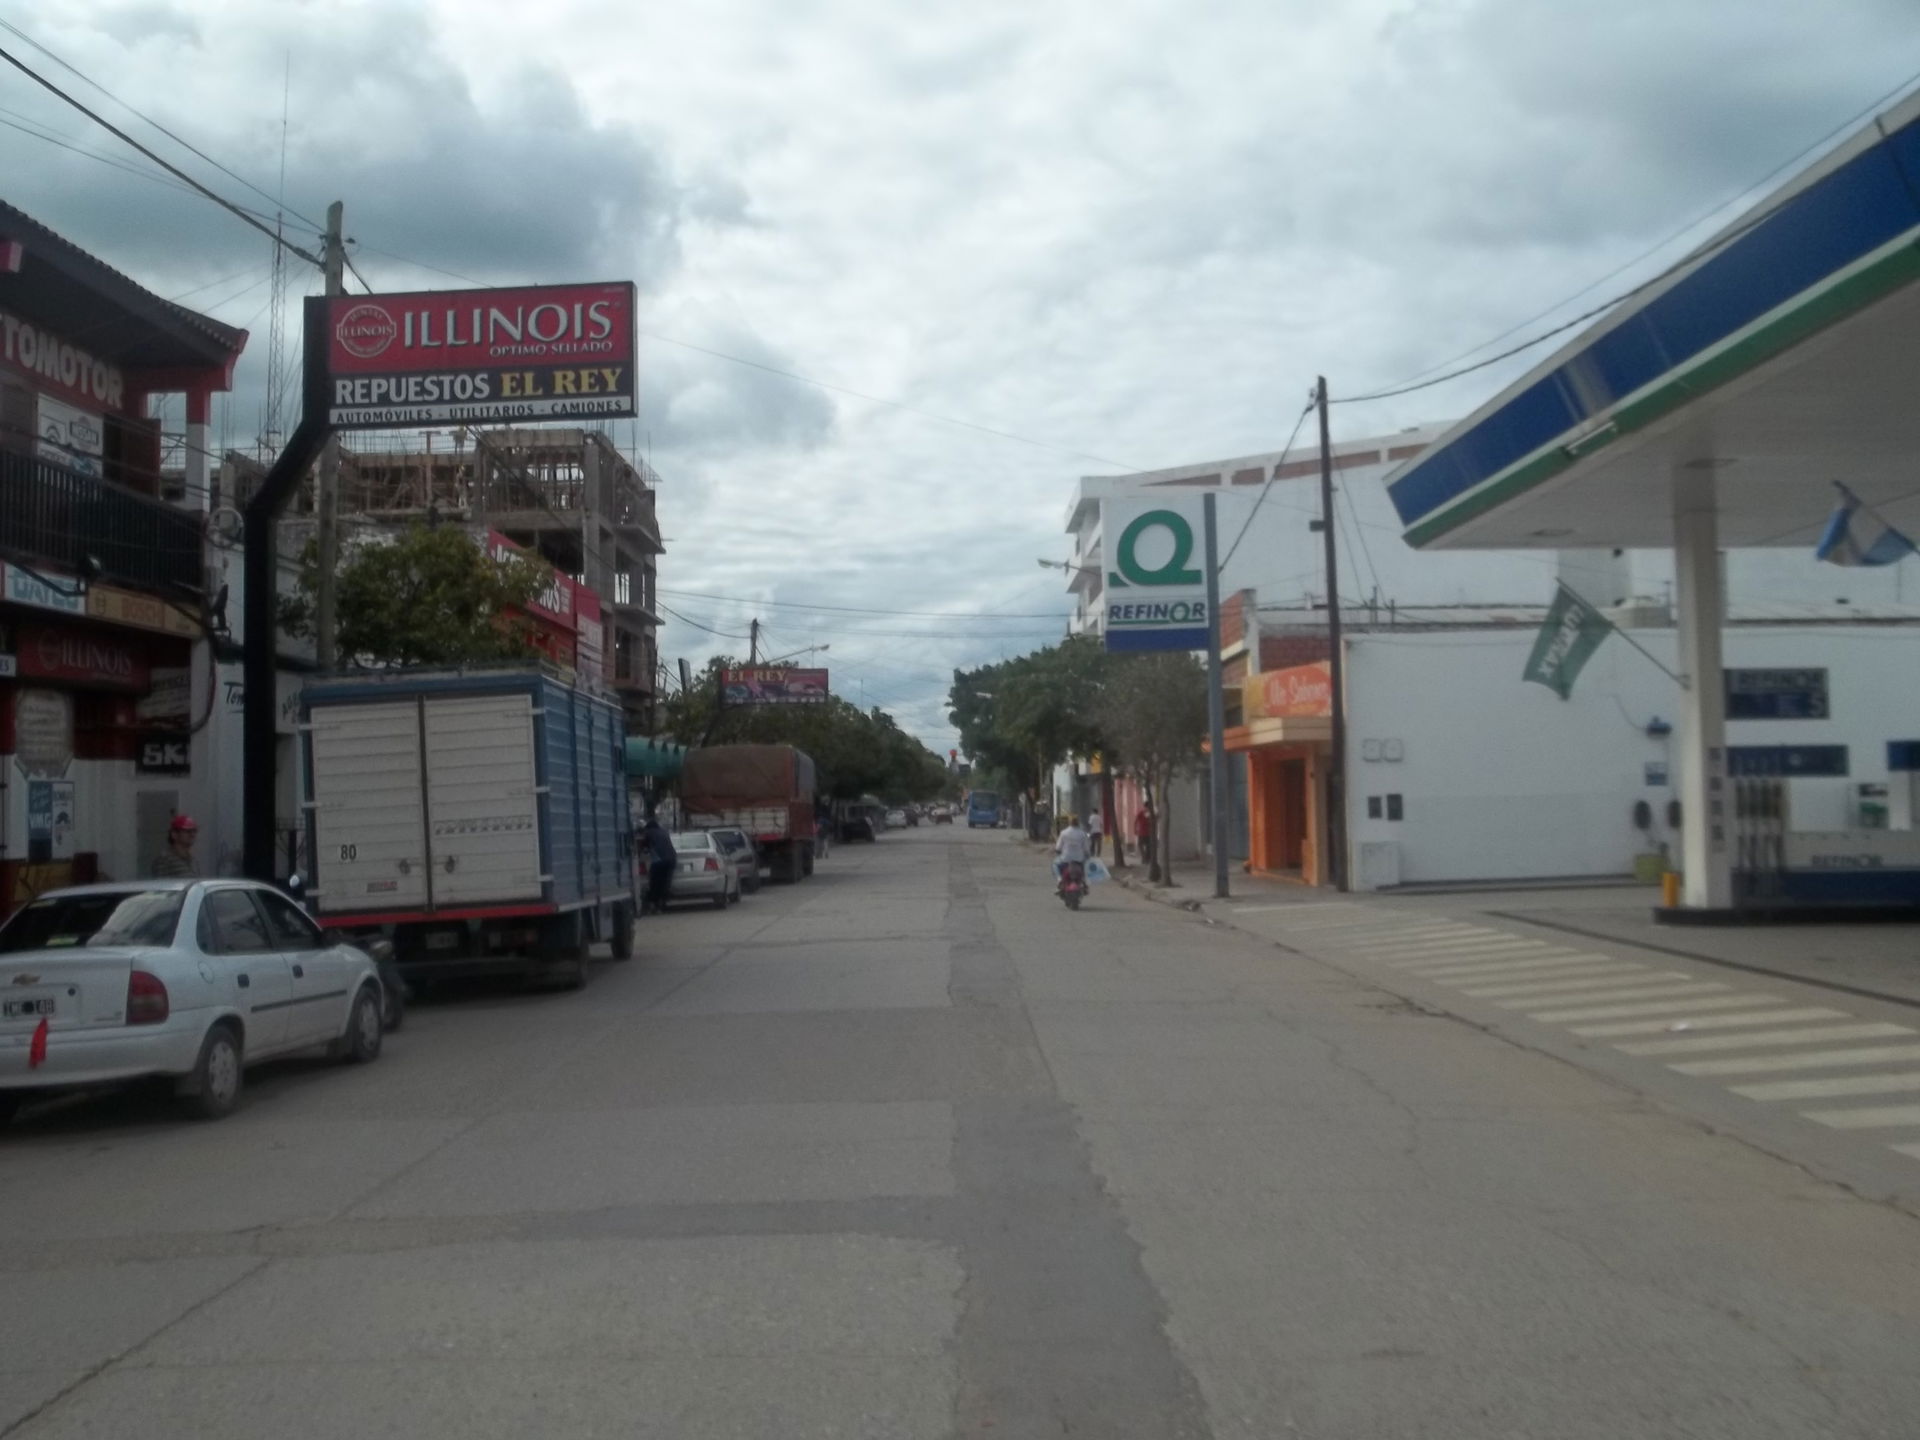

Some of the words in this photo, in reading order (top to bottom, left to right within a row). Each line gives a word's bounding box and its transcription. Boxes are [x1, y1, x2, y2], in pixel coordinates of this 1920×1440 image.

[403, 299, 613, 347] ILLINOIS
[489, 343, 547, 357] OPTIMO
[335, 373, 491, 404] REPUESTOS
[501, 372, 543, 397] EL
[554, 367, 622, 395] REY
[450, 403, 534, 419] UTILITARIOS
[551, 400, 622, 415] CAMIONES
[1108, 602, 1206, 623] REFINOR
[61, 639, 132, 675] ILLINOIS
[753, 669, 787, 682] REY
